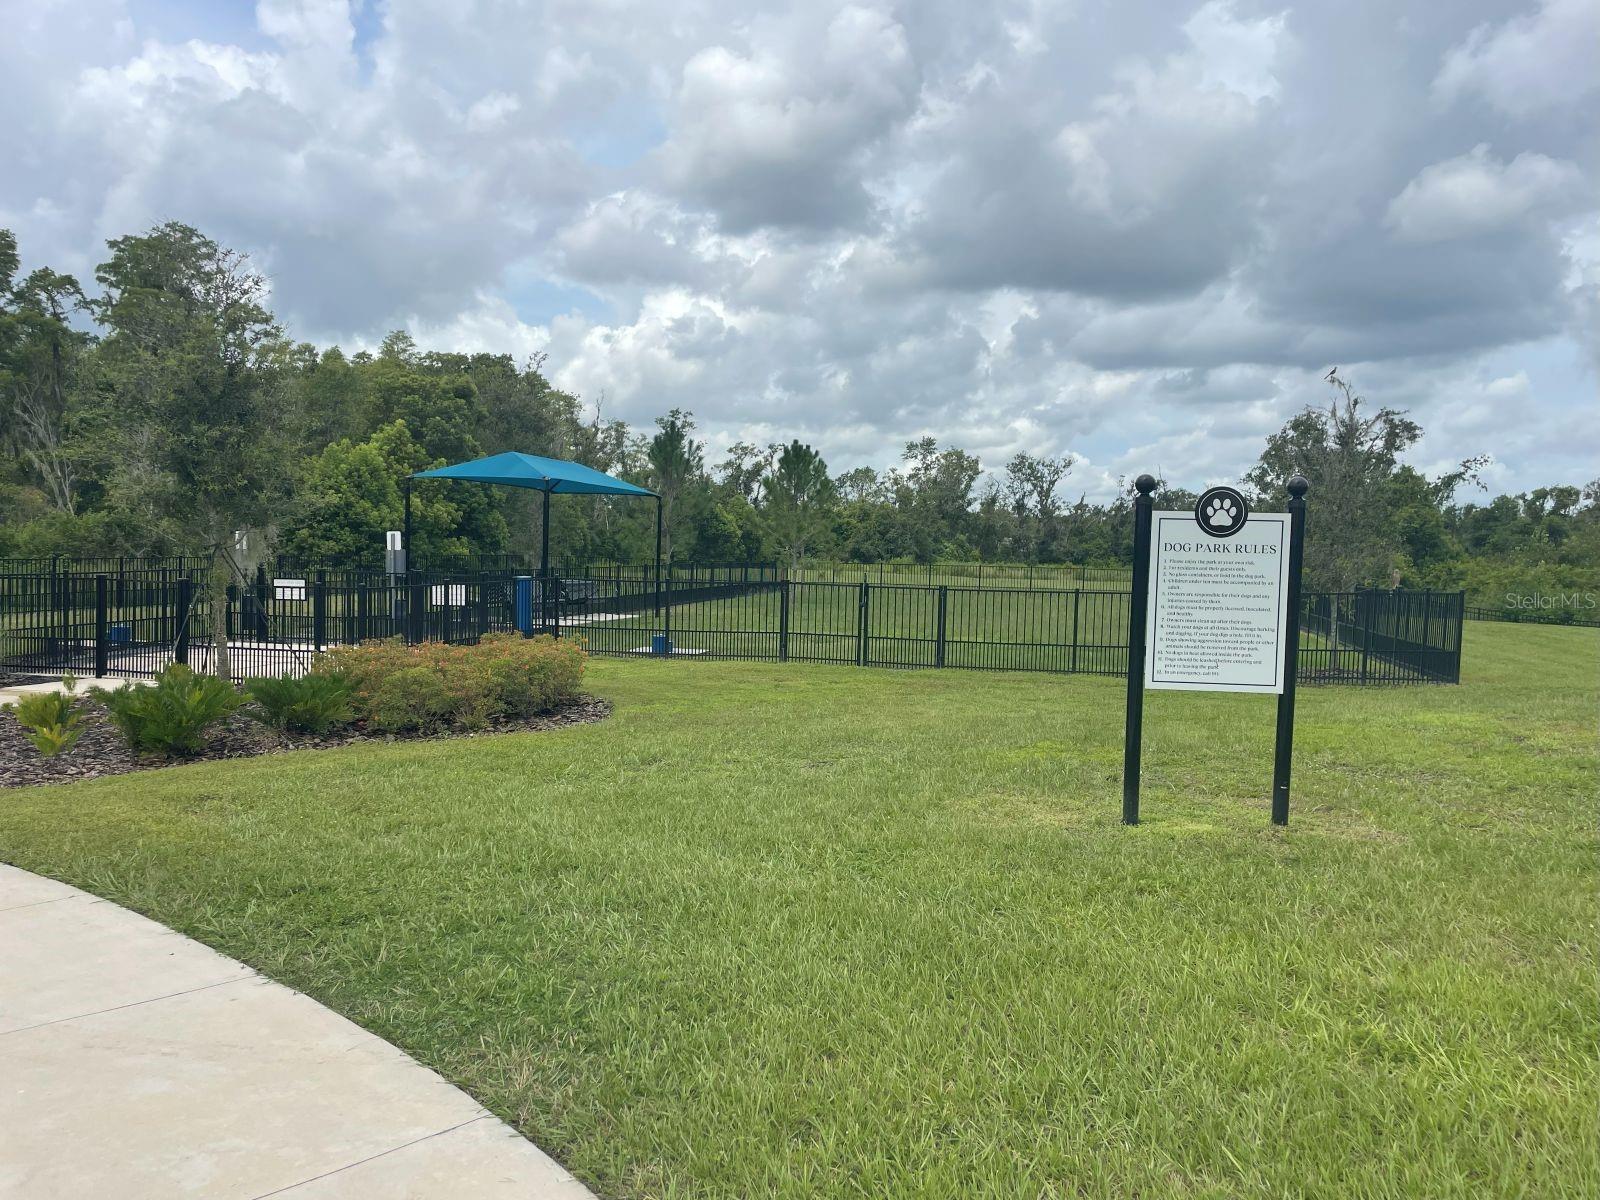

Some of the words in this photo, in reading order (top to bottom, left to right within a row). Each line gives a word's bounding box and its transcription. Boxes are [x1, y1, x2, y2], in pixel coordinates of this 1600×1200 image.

[1164, 543, 1191, 552] DOG
[1196, 544, 1231, 553] PARK
[1235, 544, 1277, 554] RULES
